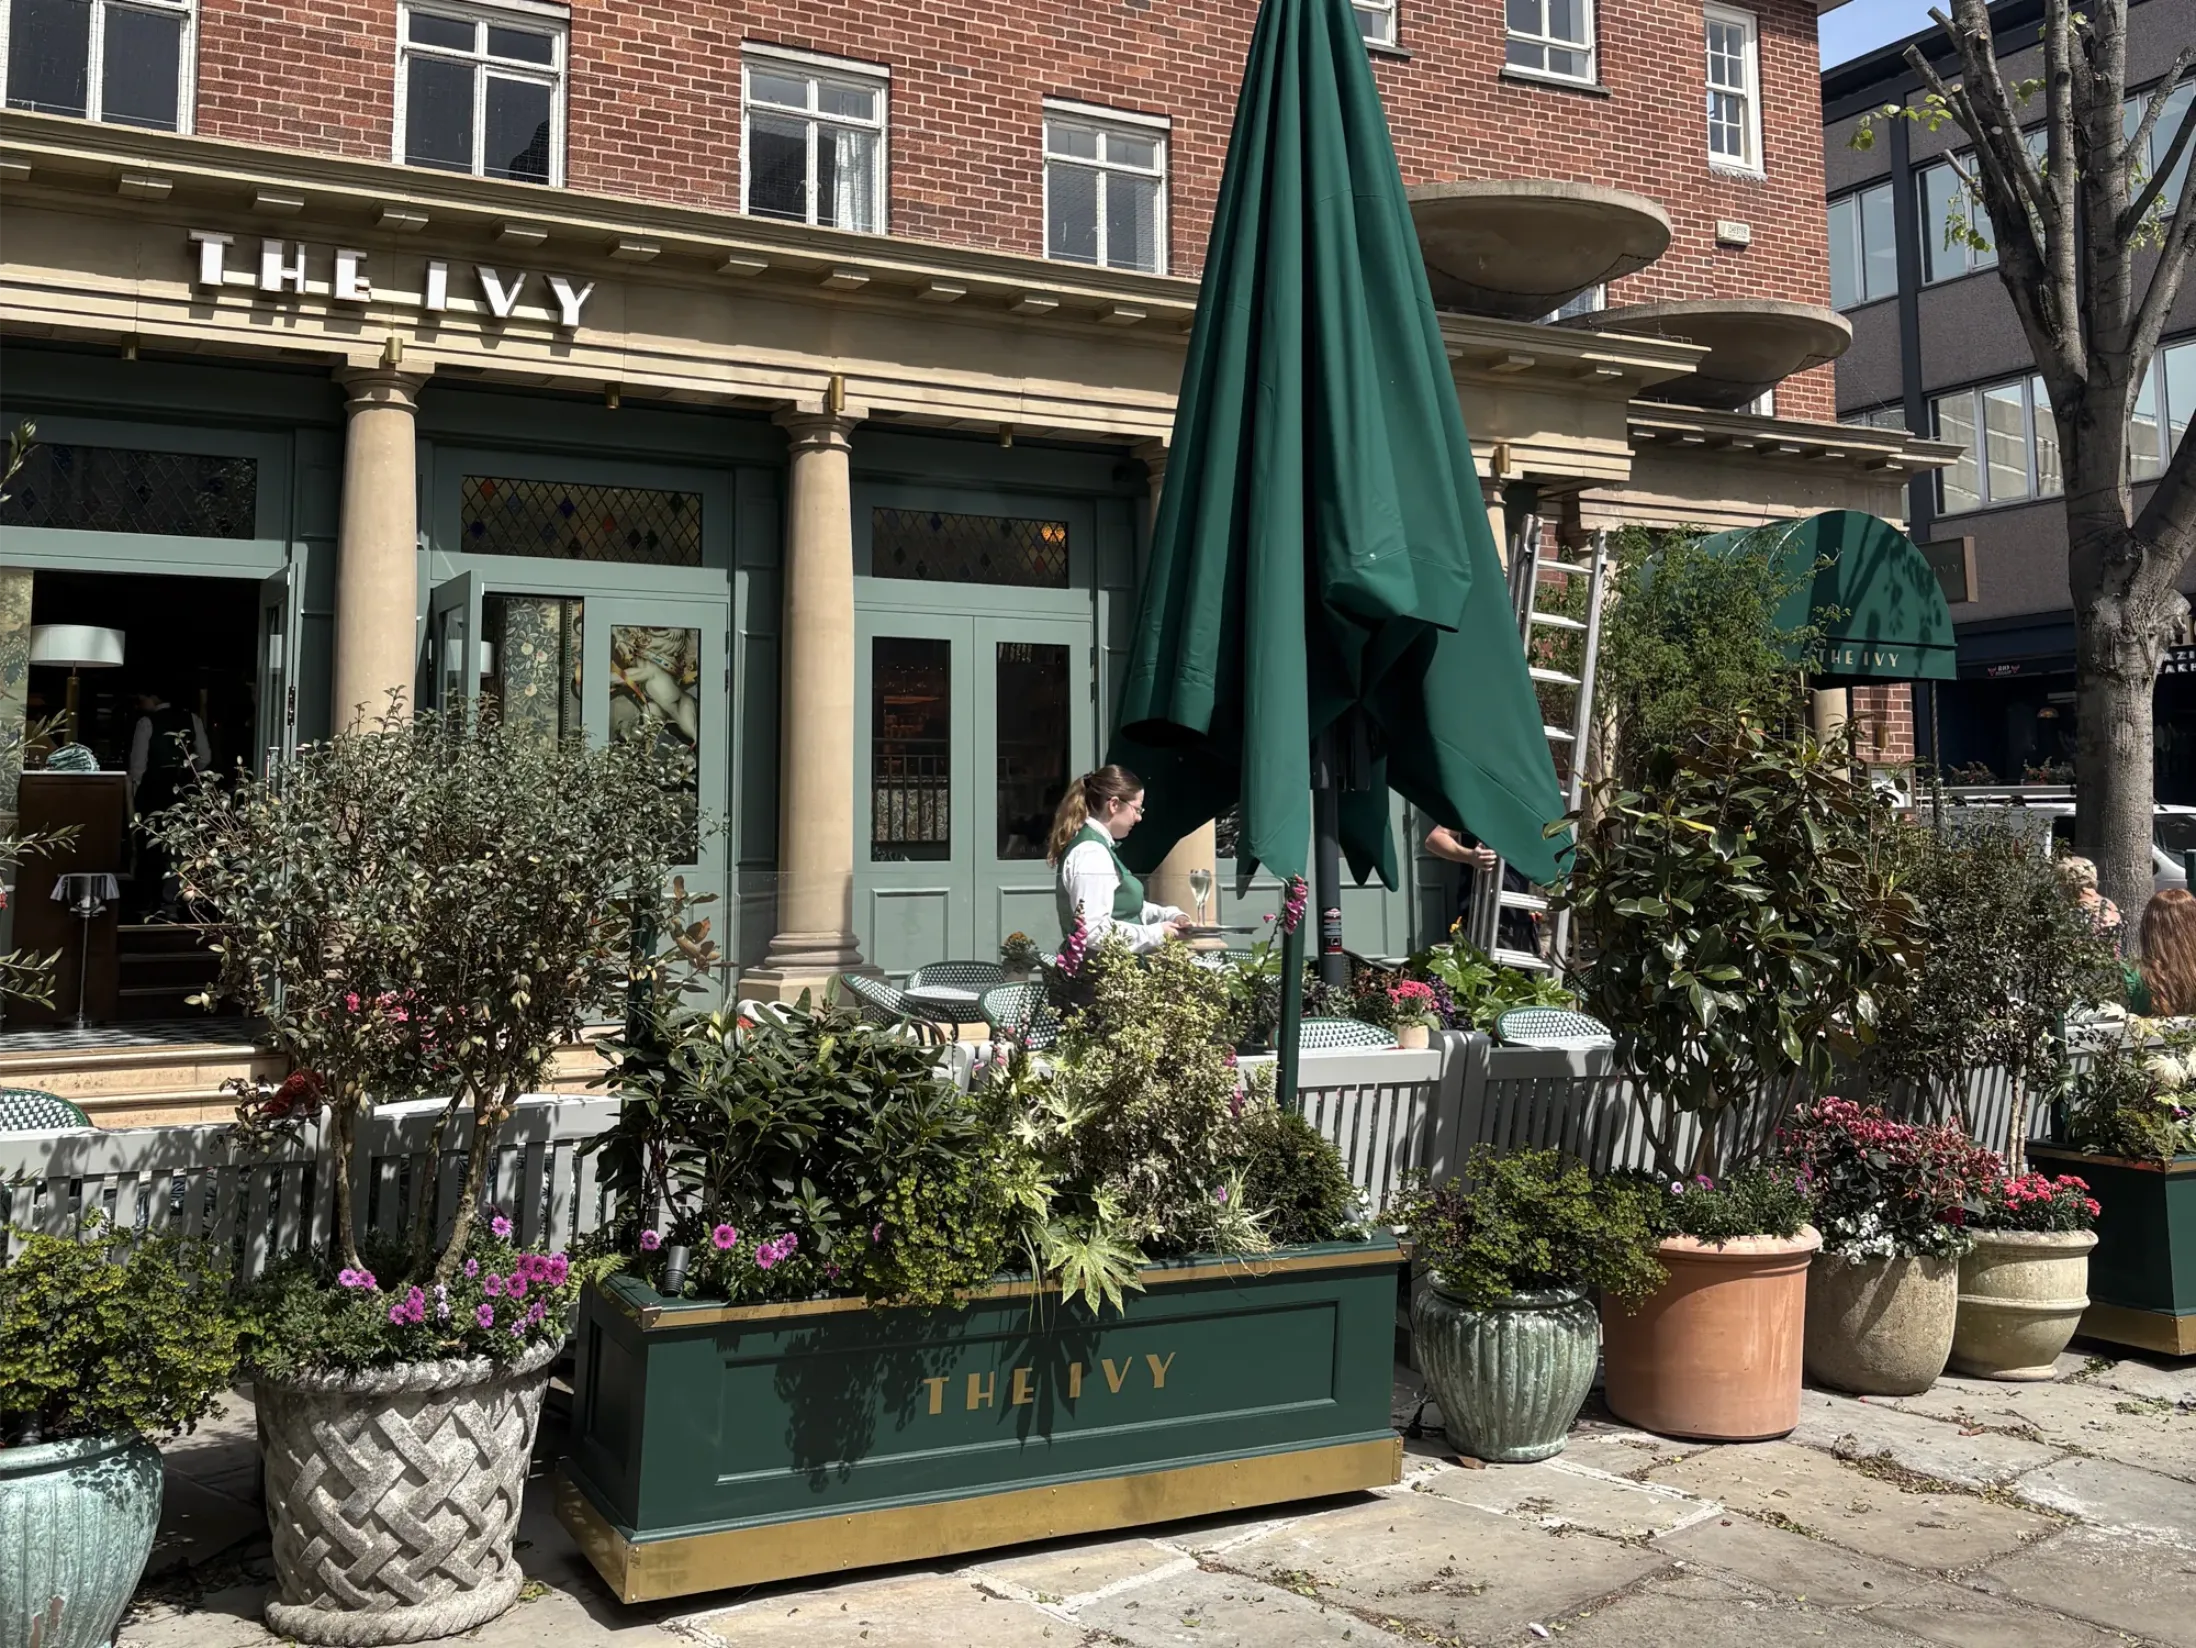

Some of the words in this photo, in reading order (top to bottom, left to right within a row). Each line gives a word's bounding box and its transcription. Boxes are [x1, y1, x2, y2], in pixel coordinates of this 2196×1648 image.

[188, 229, 372, 302] THE
[423, 259, 597, 327] IVY
[1817, 648, 1854, 665] THE
[1863, 651, 1899, 667] IVY
[923, 1367, 1035, 1415] THE
[1068, 1351, 1176, 1398] IVY
